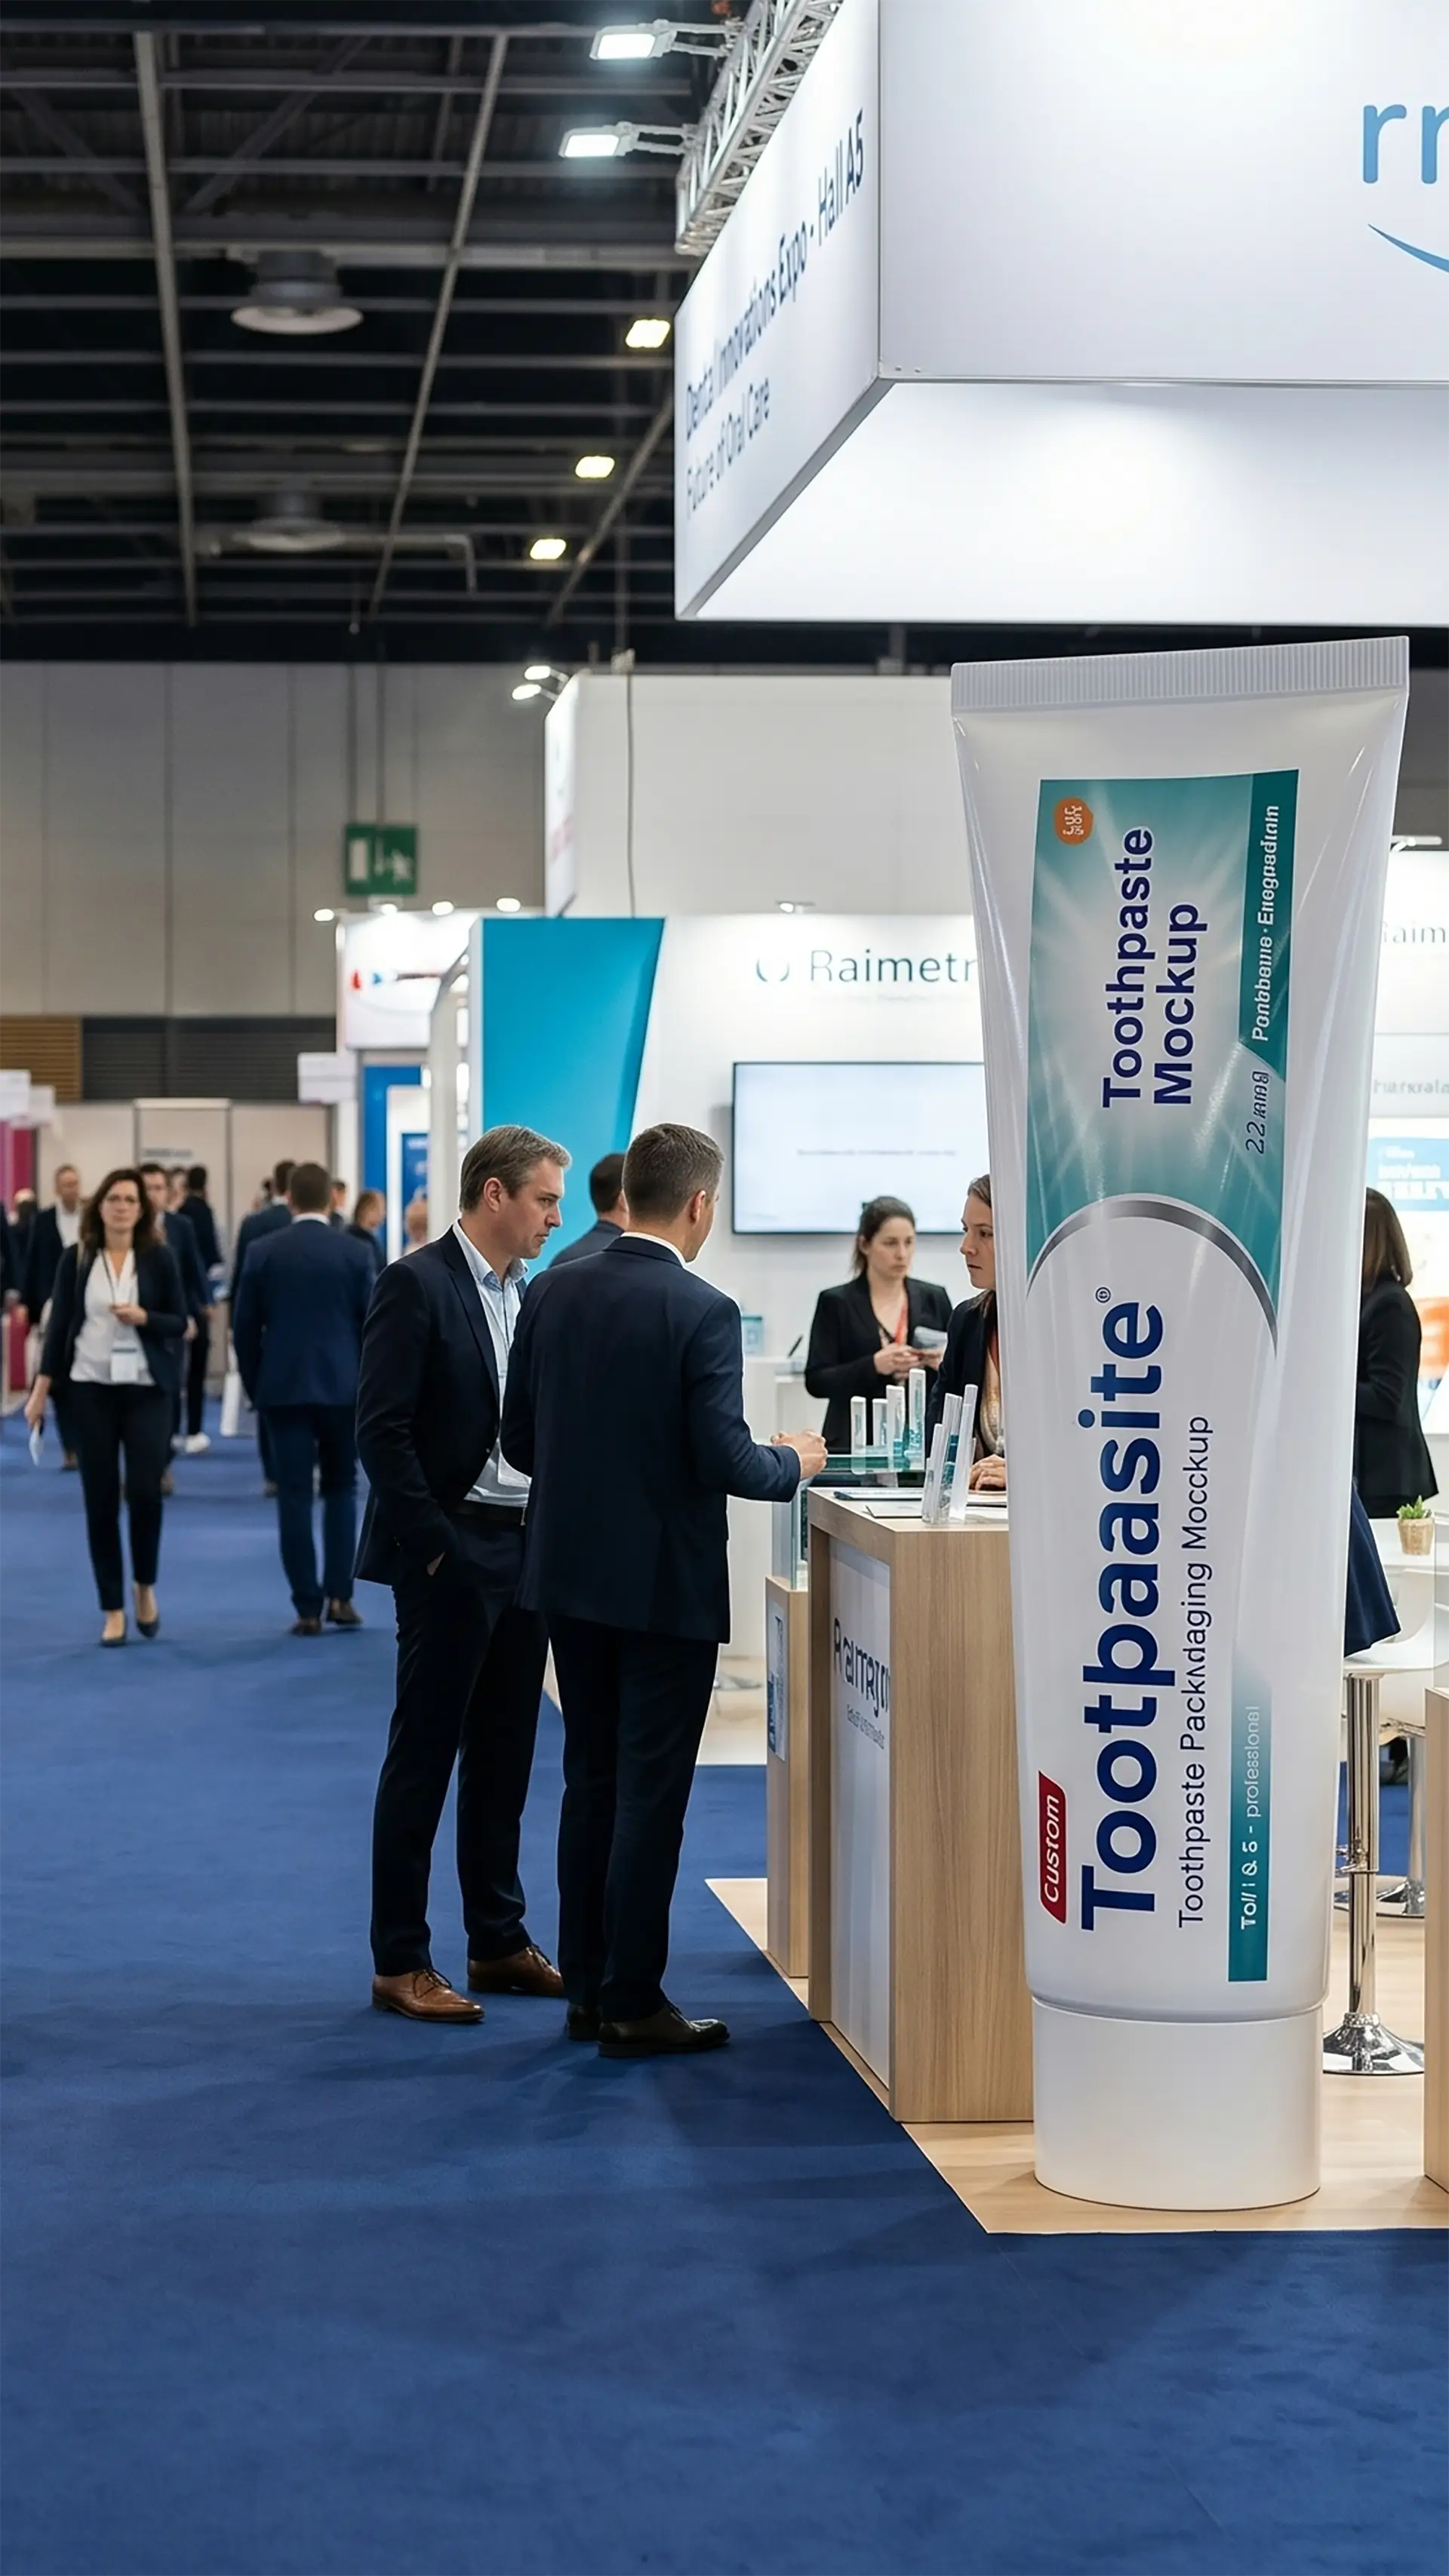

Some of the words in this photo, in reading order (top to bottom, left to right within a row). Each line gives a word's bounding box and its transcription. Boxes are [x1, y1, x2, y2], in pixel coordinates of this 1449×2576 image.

[780, 220, 807, 307] Expo
[819, 140, 843, 246] Hall
[846, 107, 863, 205] A5
[747, 377, 769, 440] Care
[1102, 828, 1155, 1108] Toothpaste
[1153, 904, 1208, 1105] Mockup
[1245, 1120, 1266, 1154] 22
[1181, 1416, 1214, 1550] Mocckup
[1179, 1763, 1211, 1928] Toothpaste
